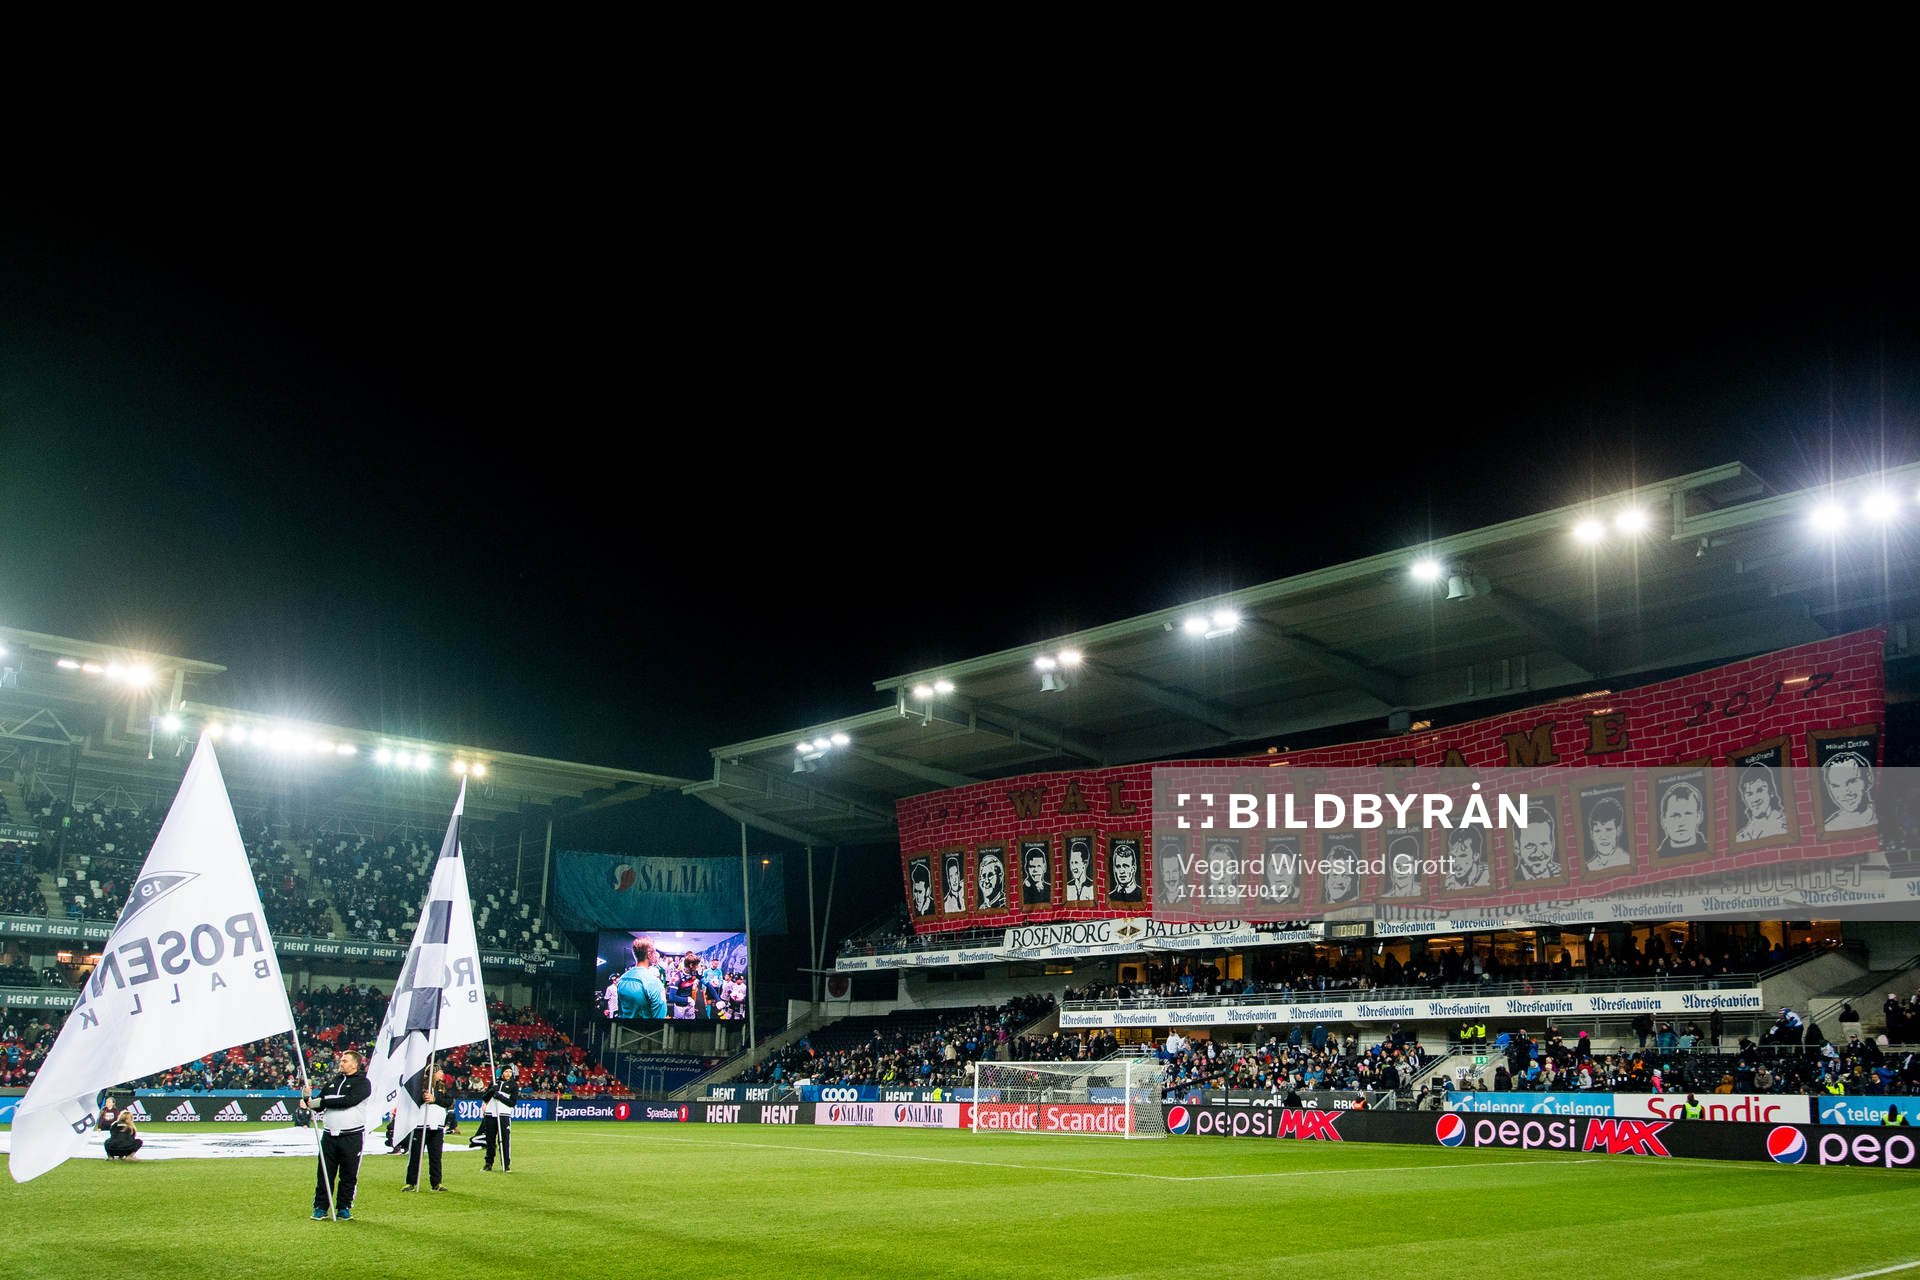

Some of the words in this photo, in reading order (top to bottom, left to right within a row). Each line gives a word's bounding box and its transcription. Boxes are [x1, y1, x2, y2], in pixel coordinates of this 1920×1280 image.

[1686, 672, 1833, 727] 2017
[11, 923, 43, 933] HENT
[48, 925, 79, 937] HENT
[1012, 922, 1110, 949] ROSENBORG
[284, 943, 310, 952] HENT
[314, 944, 340, 954] HENT
[344, 946, 369, 956] HENT
[373, 948, 398, 958] HENT
[483, 956, 505, 964] HENT
[509, 957, 526, 966] HEN
[7, 996, 40, 1005] HENT
[45, 997, 76, 1007] HENT
[712, 1088, 735, 1101] HENT
[746, 1088, 770, 1102] HENT
[885, 1092, 914, 1102] HENT
[922, 1092, 952, 1102] HET
[556, 1105, 614, 1119] SpareBank
[1473, 1097, 1525, 1113] telenor
[1555, 1099, 1611, 1117] telenor
[1647, 1097, 1781, 1123] Scndic
[166, 1111, 200, 1122] adidas
[214, 1111, 248, 1122] adidas
[261, 1111, 293, 1122] adidas
[647, 1107, 679, 1120] SpareBank
[707, 1105, 741, 1123] HENT
[761, 1105, 798, 1124] HENT
[968, 1106, 1039, 1130] Scandic
[1047, 1106, 1126, 1132] Scandic
[1847, 1107, 1908, 1121] telenr
[1196, 1107, 1273, 1137] pepsi
[1277, 1109, 1345, 1142] MAX
[1474, 1119, 1578, 1152] pepsi
[1582, 1118, 1673, 1158] MAX
